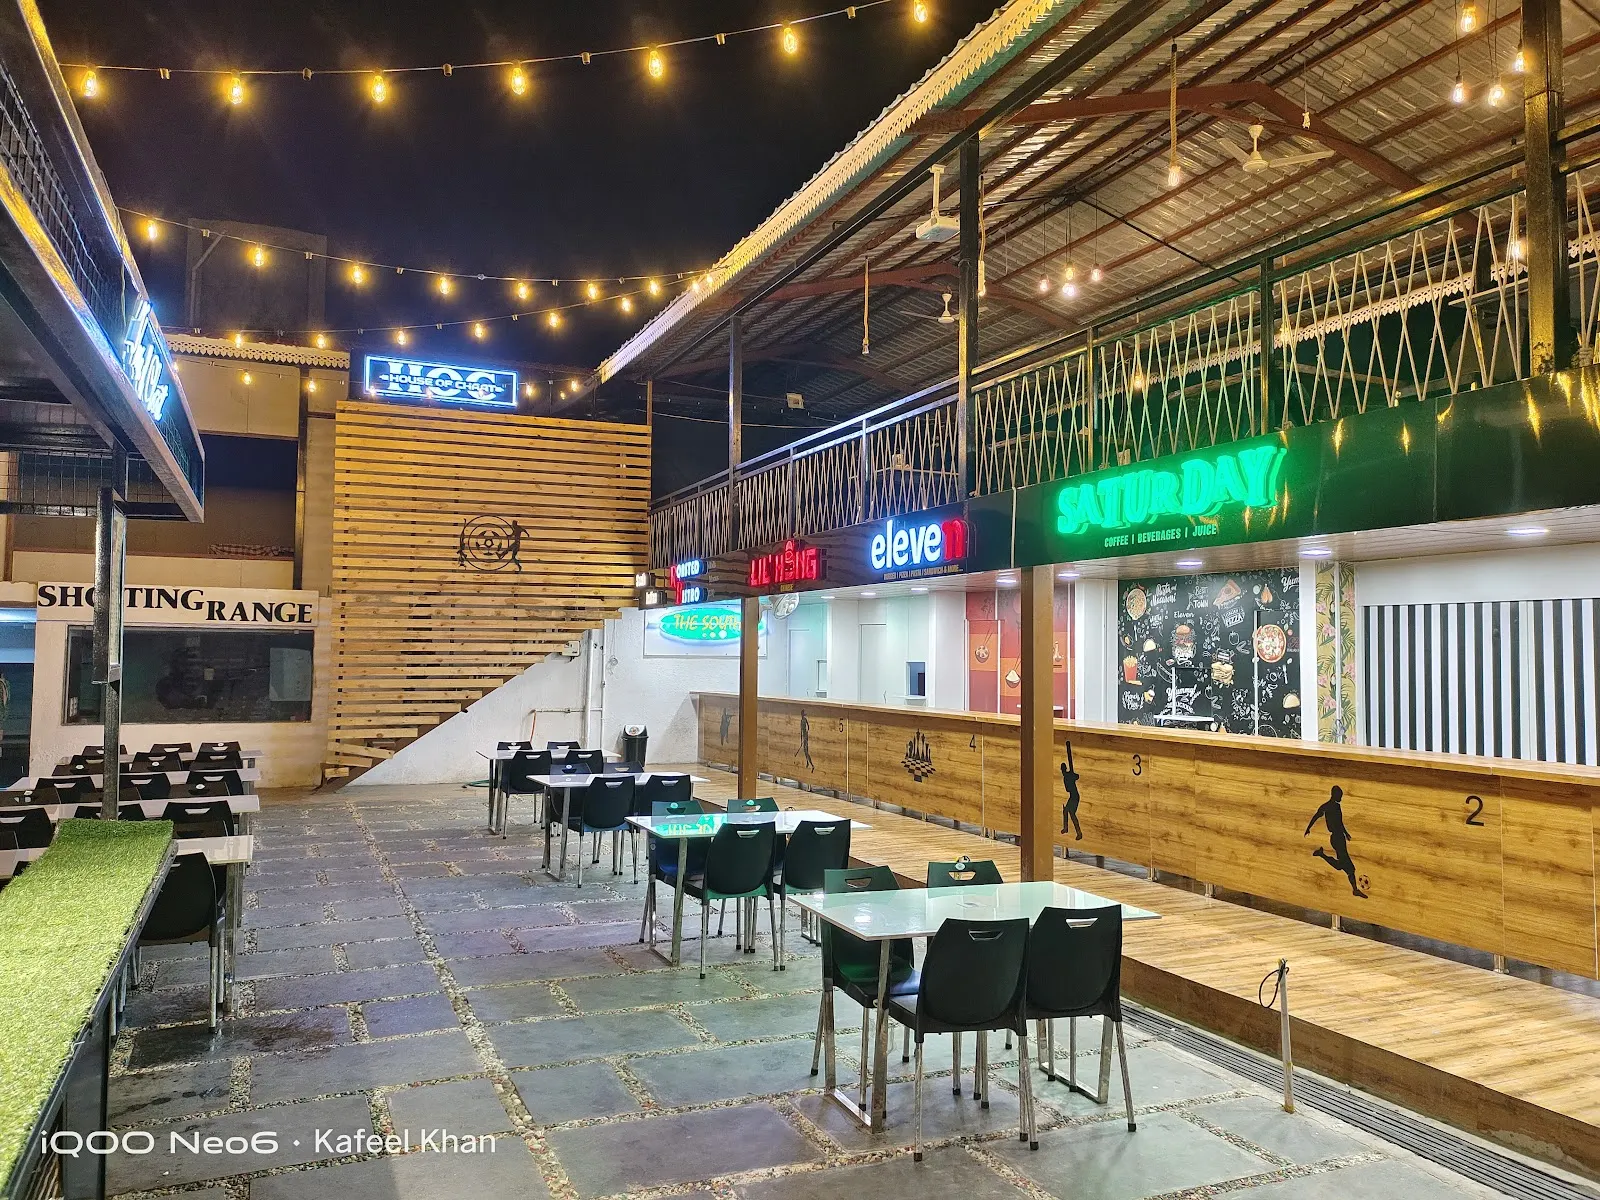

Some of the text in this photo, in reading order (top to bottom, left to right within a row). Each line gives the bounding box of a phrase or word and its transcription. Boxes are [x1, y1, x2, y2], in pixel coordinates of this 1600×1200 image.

[390, 373, 498, 393] HOUSE OF CHAAT
[1057, 446, 1281, 534] SATURDAY
[871, 519, 966, 570] eleven
[1104, 523, 1217, 548] COFFEE BEVERAGES JUICE
[37, 584, 313, 624] SHTING RANGE
[1192, 599, 1209, 609] TOWN
[673, 613, 699, 631] THE
[838, 717, 845, 733] 5
[969, 734, 977, 752] 4
[1131, 754, 1142, 776] 3
[1465, 795, 1485, 827] 2
